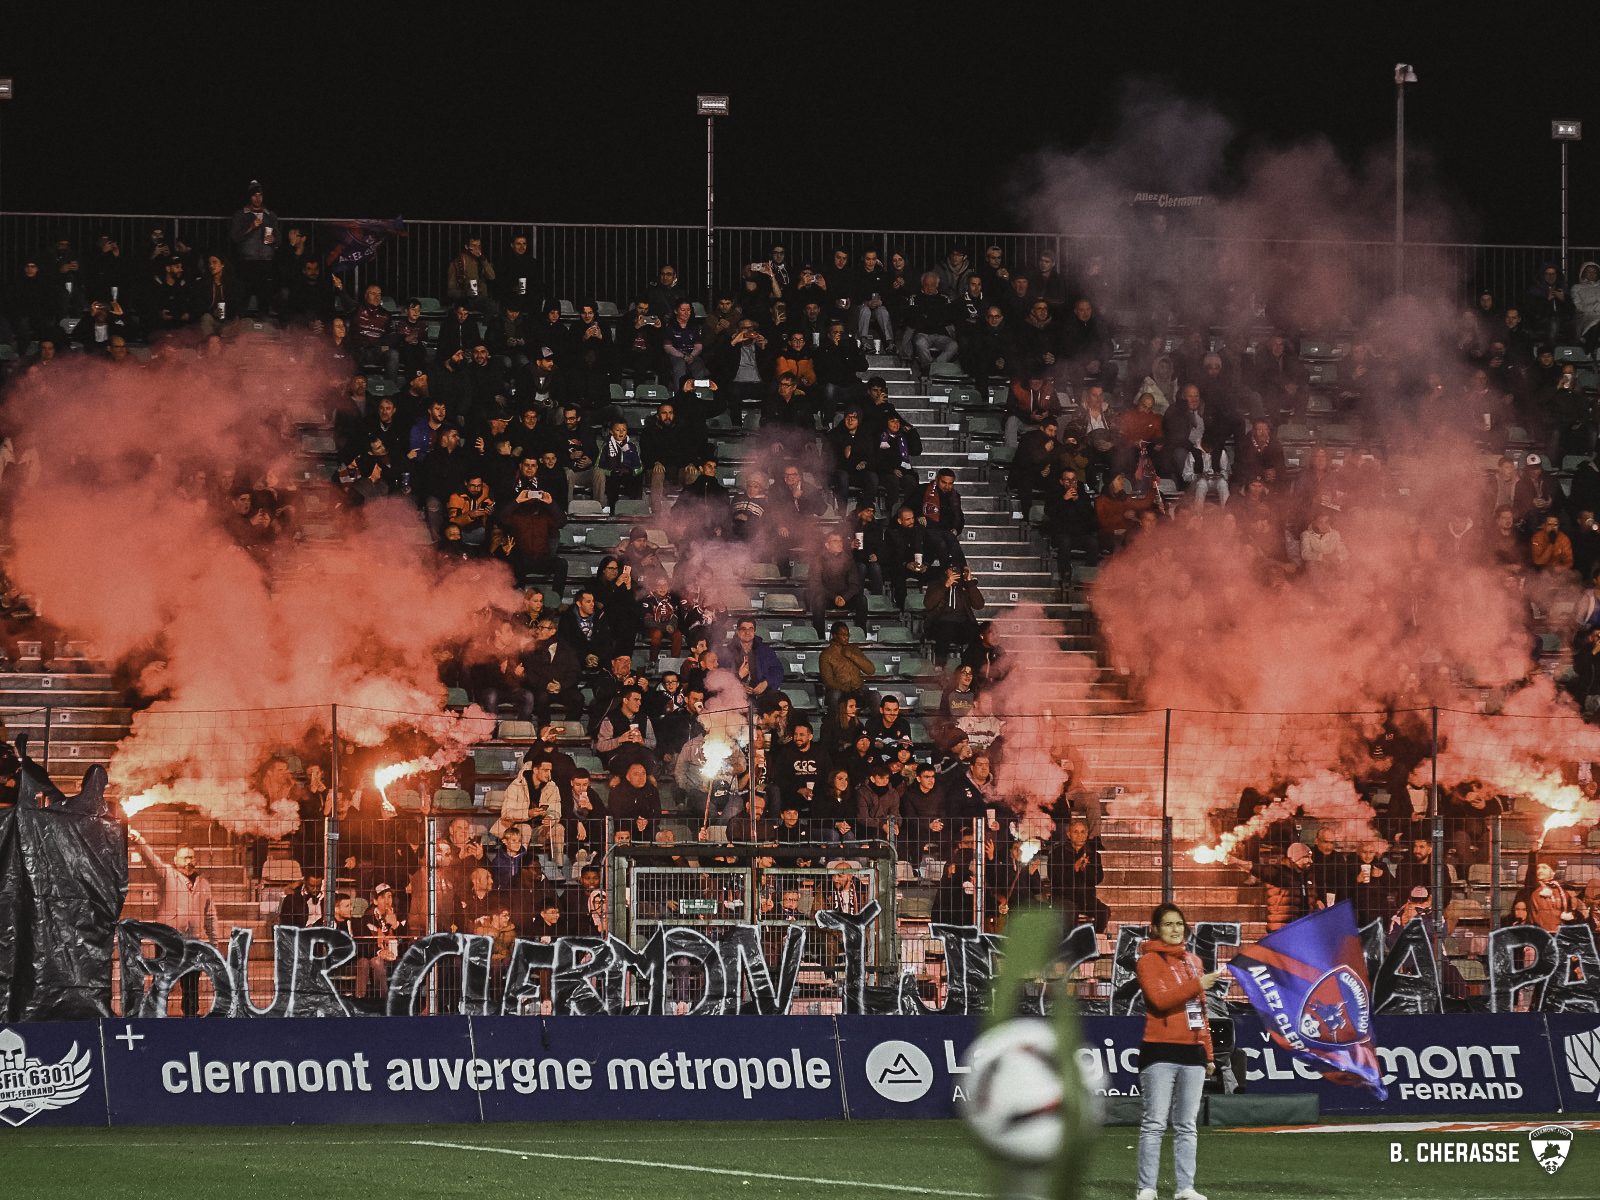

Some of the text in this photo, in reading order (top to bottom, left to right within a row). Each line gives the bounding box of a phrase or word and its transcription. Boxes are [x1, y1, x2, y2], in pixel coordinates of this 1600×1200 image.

[114, 918, 358, 1018] POUR
[1248, 965, 1283, 1012] ALLEZ
[1339, 972, 1367, 1011] CLERMONT
[1303, 1019, 1318, 1036] 63
[29, 1066, 71, 1086] 6301
[161, 1048, 832, 1099] clermont auvergne métropole
